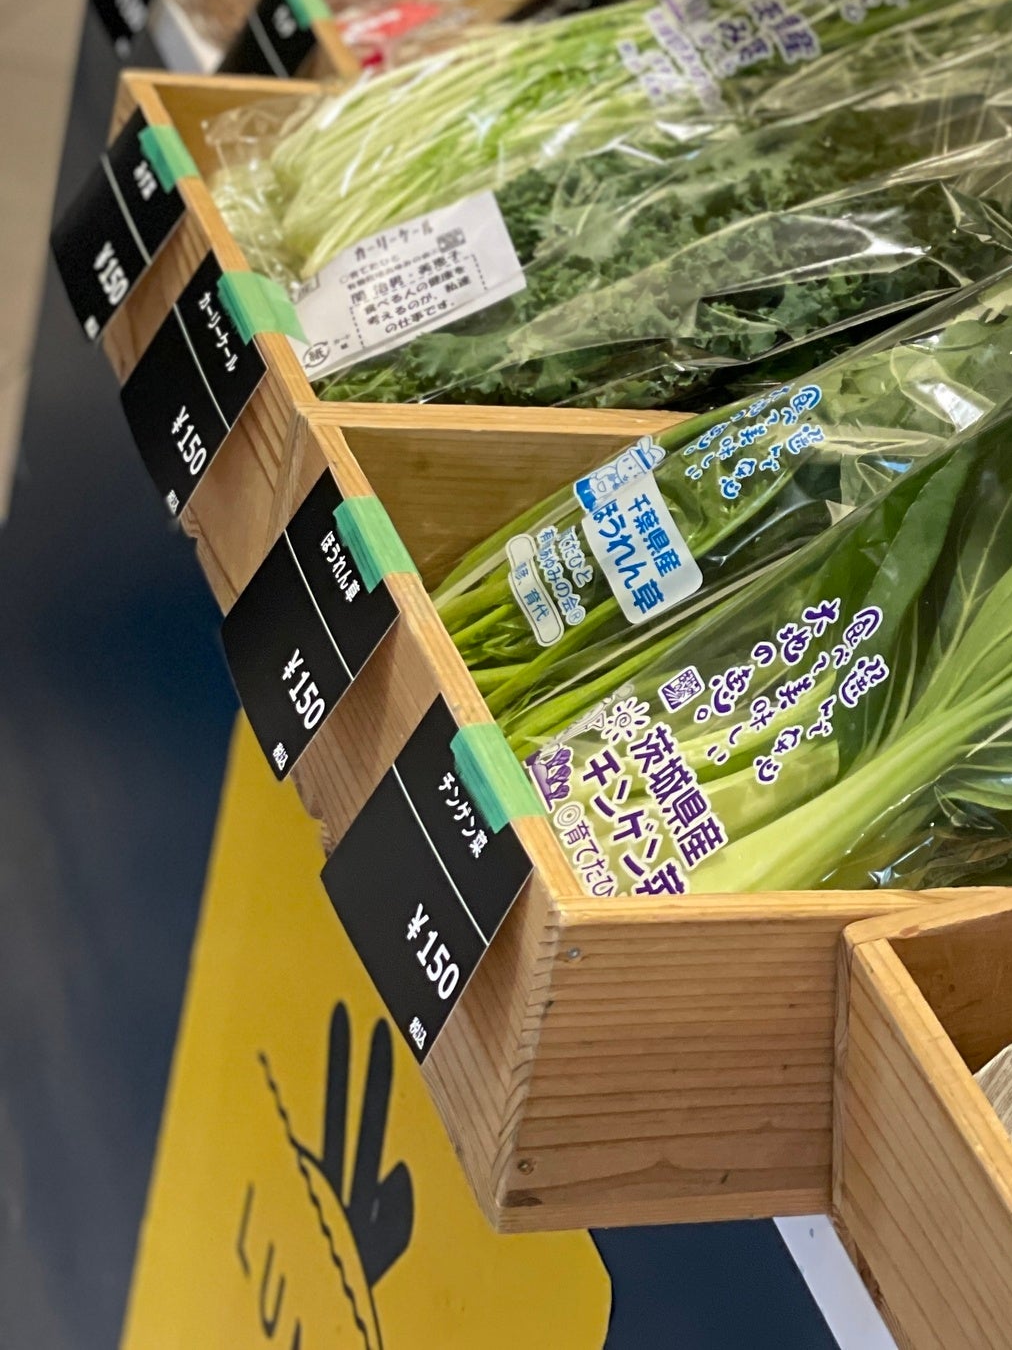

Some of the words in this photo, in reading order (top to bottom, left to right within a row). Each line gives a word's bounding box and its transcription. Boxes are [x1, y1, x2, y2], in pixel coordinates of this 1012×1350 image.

[93, 241, 129, 306] ¥150
[199, 291, 240, 372] カーリーケール
[171, 405, 208, 476] ¥150
[320, 530, 362, 603] ほうれん草
[592, 500, 665, 615] ほうれん草
[628, 493, 682, 578] 千葉県産
[281, 648, 325, 730] ¥150
[438, 771, 489, 859] チンゲン菜
[629, 725, 725, 868] 茨城県産
[406, 903, 460, 1000] ¥150
[408, 1016, 427, 1050] 税込
